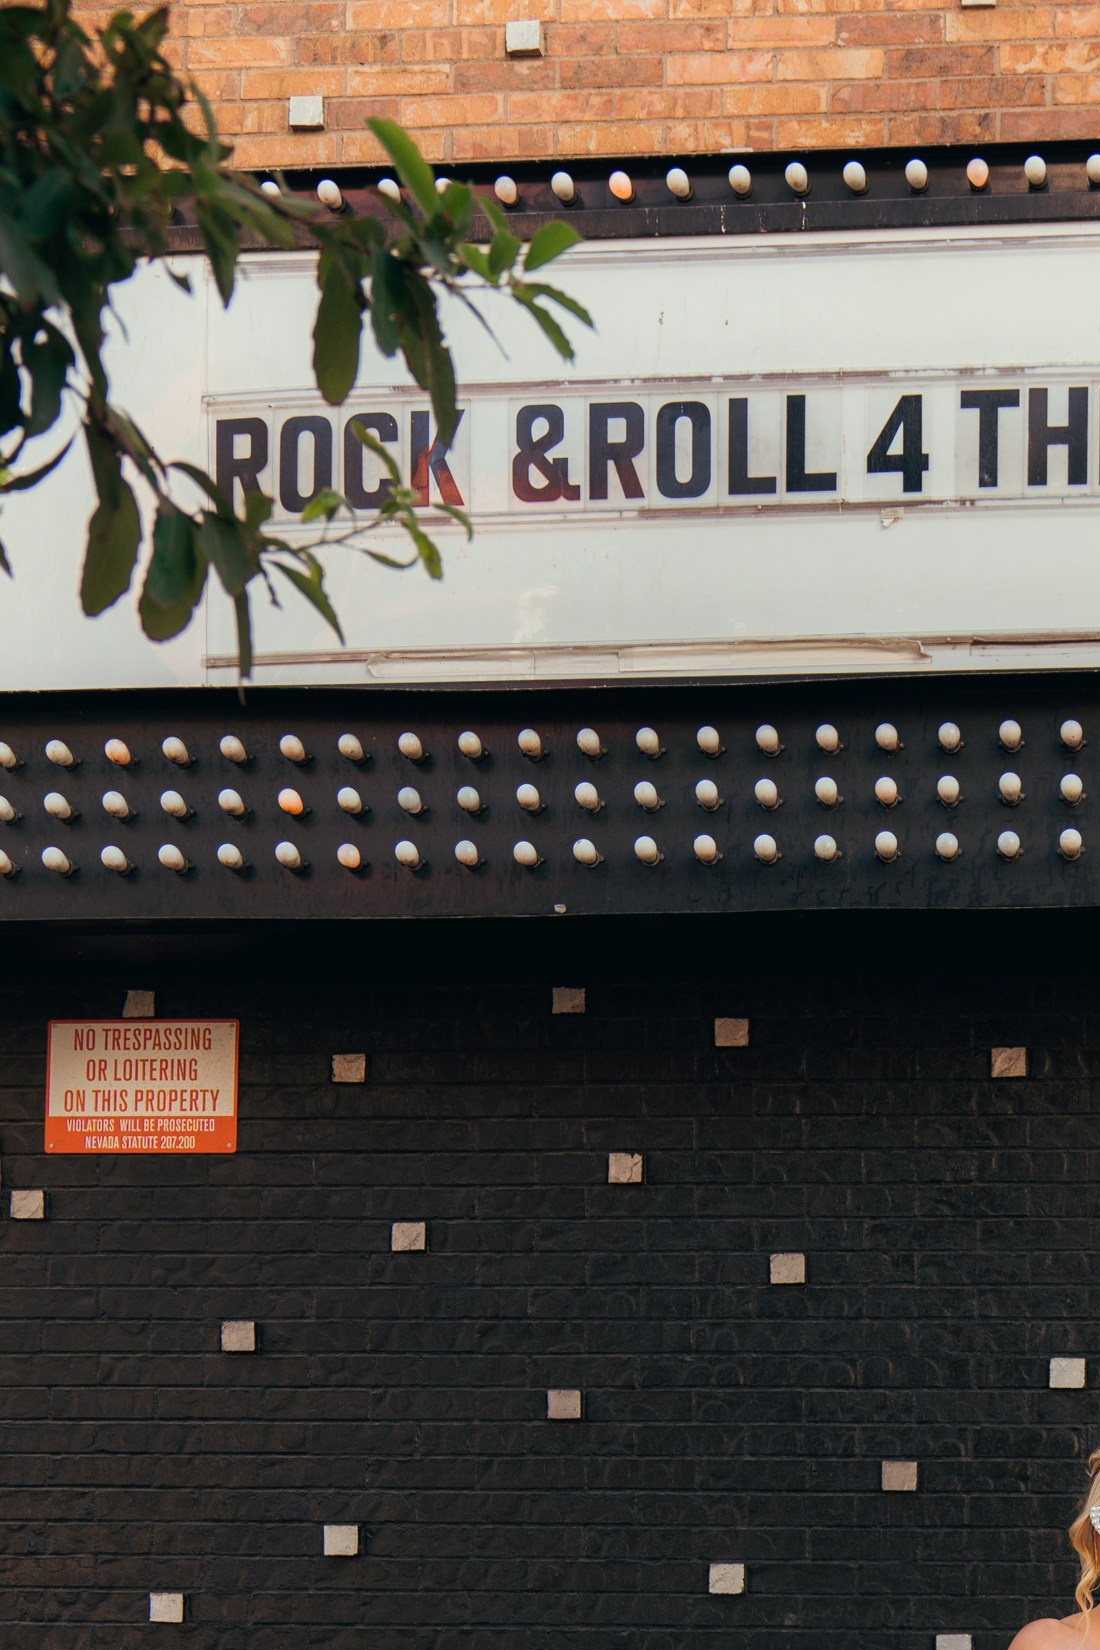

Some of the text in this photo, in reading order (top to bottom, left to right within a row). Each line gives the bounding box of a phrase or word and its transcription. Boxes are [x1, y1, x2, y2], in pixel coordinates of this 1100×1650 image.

[215, 408, 466, 514] ROCK
[866, 393, 930, 493] 4
[74, 1027, 212, 1051] NO TRESPASSING
[86, 1058, 198, 1082] OR LOITERING
[63, 1089, 220, 1112] ON THIS PROPERTY
[66, 1118, 215, 1132] VIOLATORS WILL BE PROSECUTED
[85, 1135, 196, 1149] NEVADA STATUTE 207.200
